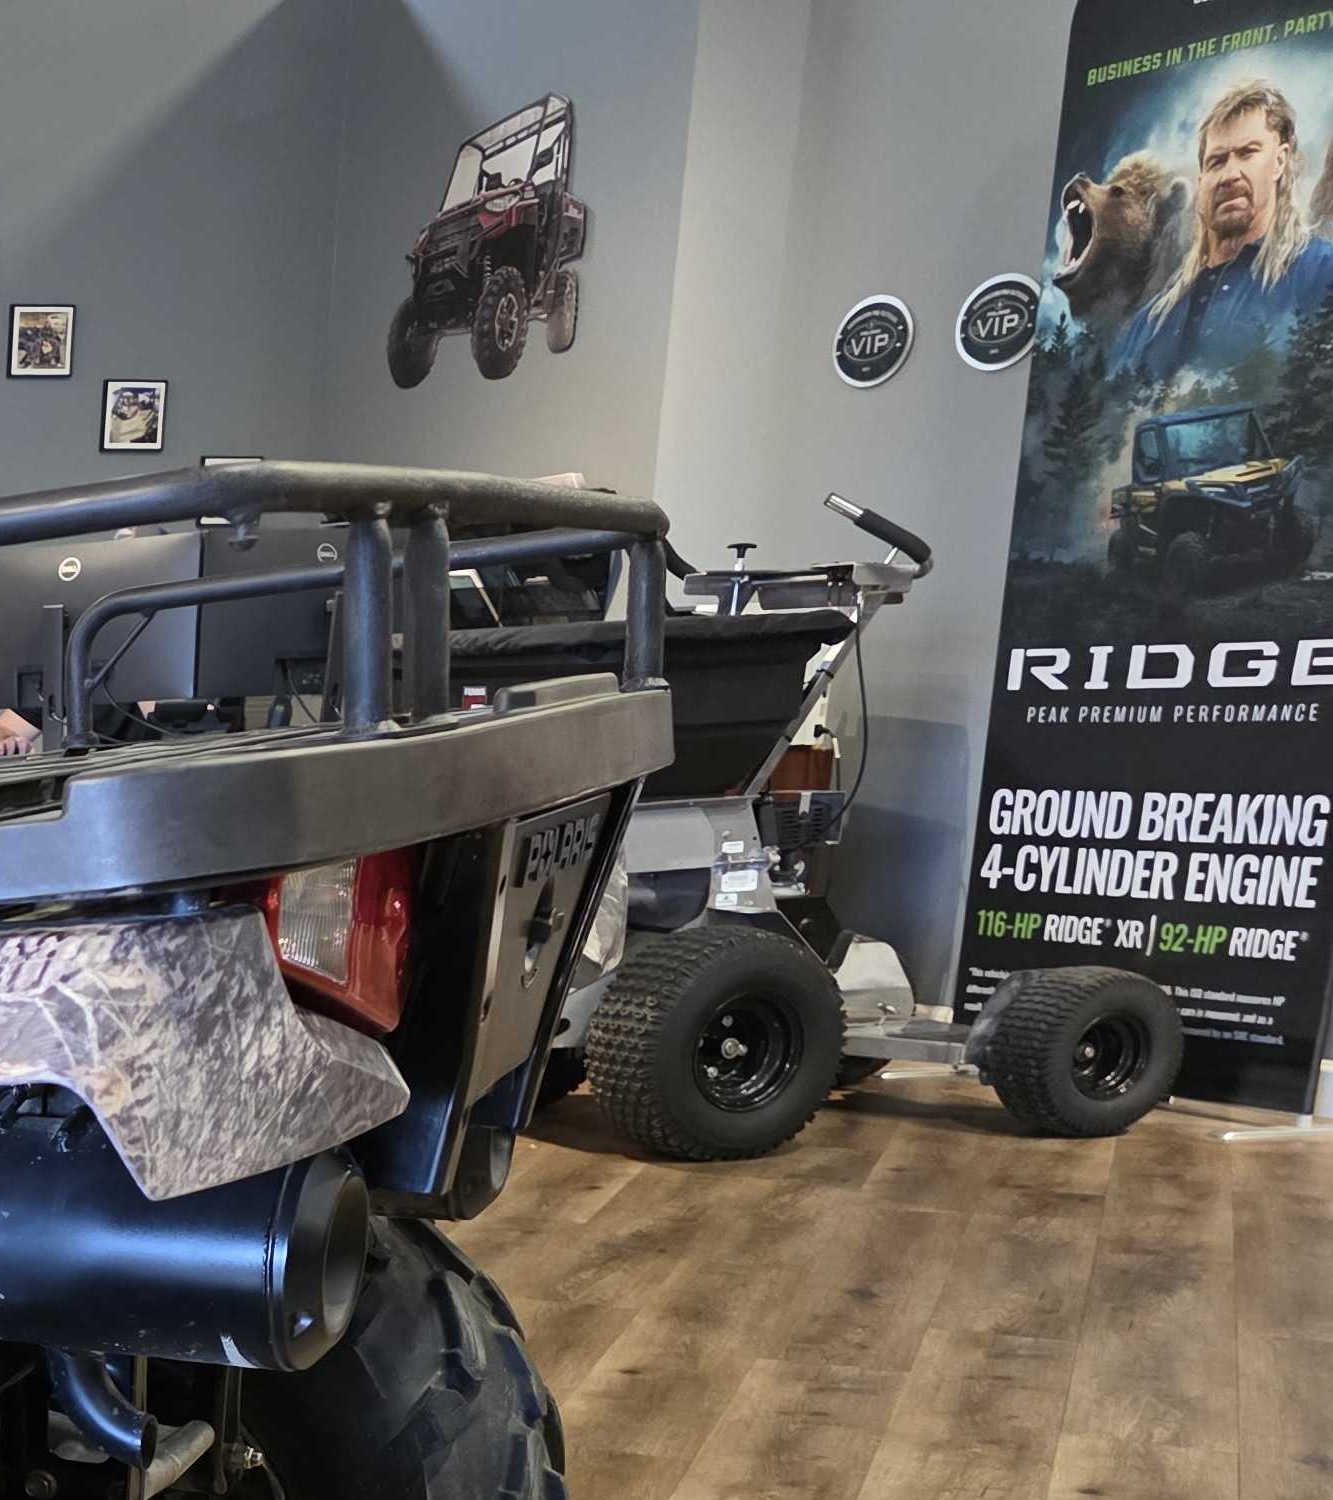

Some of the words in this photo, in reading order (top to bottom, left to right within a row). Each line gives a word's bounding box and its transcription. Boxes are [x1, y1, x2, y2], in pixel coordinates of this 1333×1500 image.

[1087, 52, 1162, 87] BUSINESS
[1165, 47, 1183, 68] IN
[1188, 37, 1217, 62] THE
[1221, 23, 1278, 53] FRONT.
[851, 333, 890, 356] VIP
[977, 314, 1019, 338] VIP
[1007, 639, 1333, 691] RIDGE
[1026, 706, 1070, 724] PEAK
[1078, 705, 1163, 724] PREMIUM
[1173, 703, 1320, 723] PERFORMANCE
[989, 788, 1133, 840] GROUND
[1138, 792, 1331, 847] BREAKING
[980, 844, 1179, 900] 4-CYLINDER
[1184, 852, 1323, 909] ENGINE
[977, 910, 1042, 940] 116-HP
[1114, 918, 1145, 949] XR
[1159, 922, 1227, 955] 92-HP
